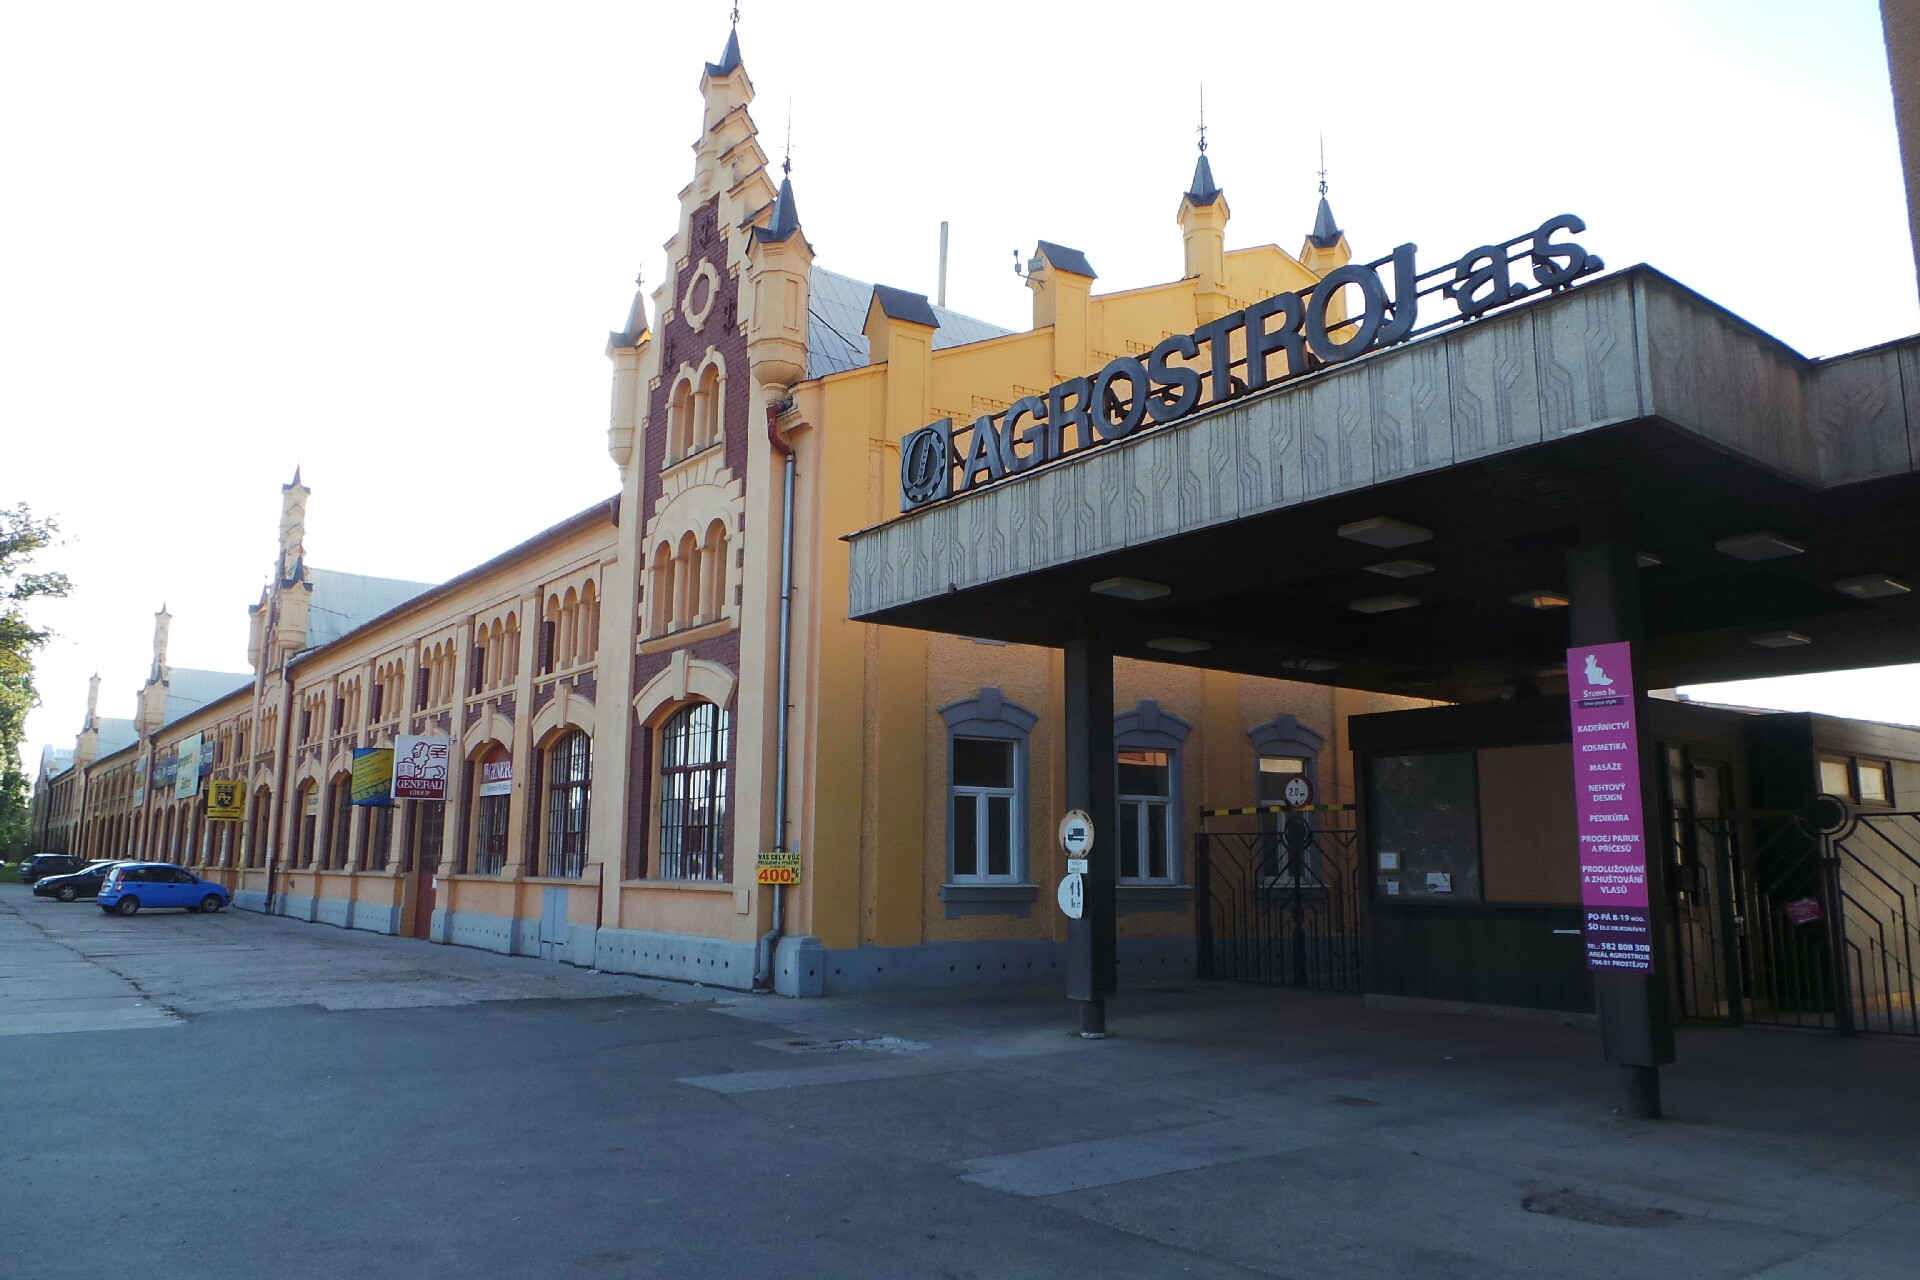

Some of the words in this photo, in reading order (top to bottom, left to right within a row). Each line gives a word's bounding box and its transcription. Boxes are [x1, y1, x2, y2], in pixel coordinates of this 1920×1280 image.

[961, 242, 1417, 491] AGROSTROJ
[1577, 721, 1629, 733] KADEŘNICTVÍ
[1582, 742, 1627, 752] KOSMETIKA
[1589, 763, 1622, 772] MASÁŽE
[397, 780, 443, 789] GENERALI
[1588, 782, 1625, 792] NEHTOVÝ
[1593, 794, 1623, 802] DESIGN
[1590, 814, 1629, 822] PEDIKÚRA
[1598, 844, 1631, 852] PŘÍČESŮ
[1582, 864, 1644, 873] PRODLUŽOVÁNÍ
[1600, 885, 1627, 894] VLASŮ
[1588, 913, 1611, 921] PO-PÁ
[1610, 952, 1650, 960] AGROSTROJE
[1612, 960, 1648, 968] PROSTĚJOV
